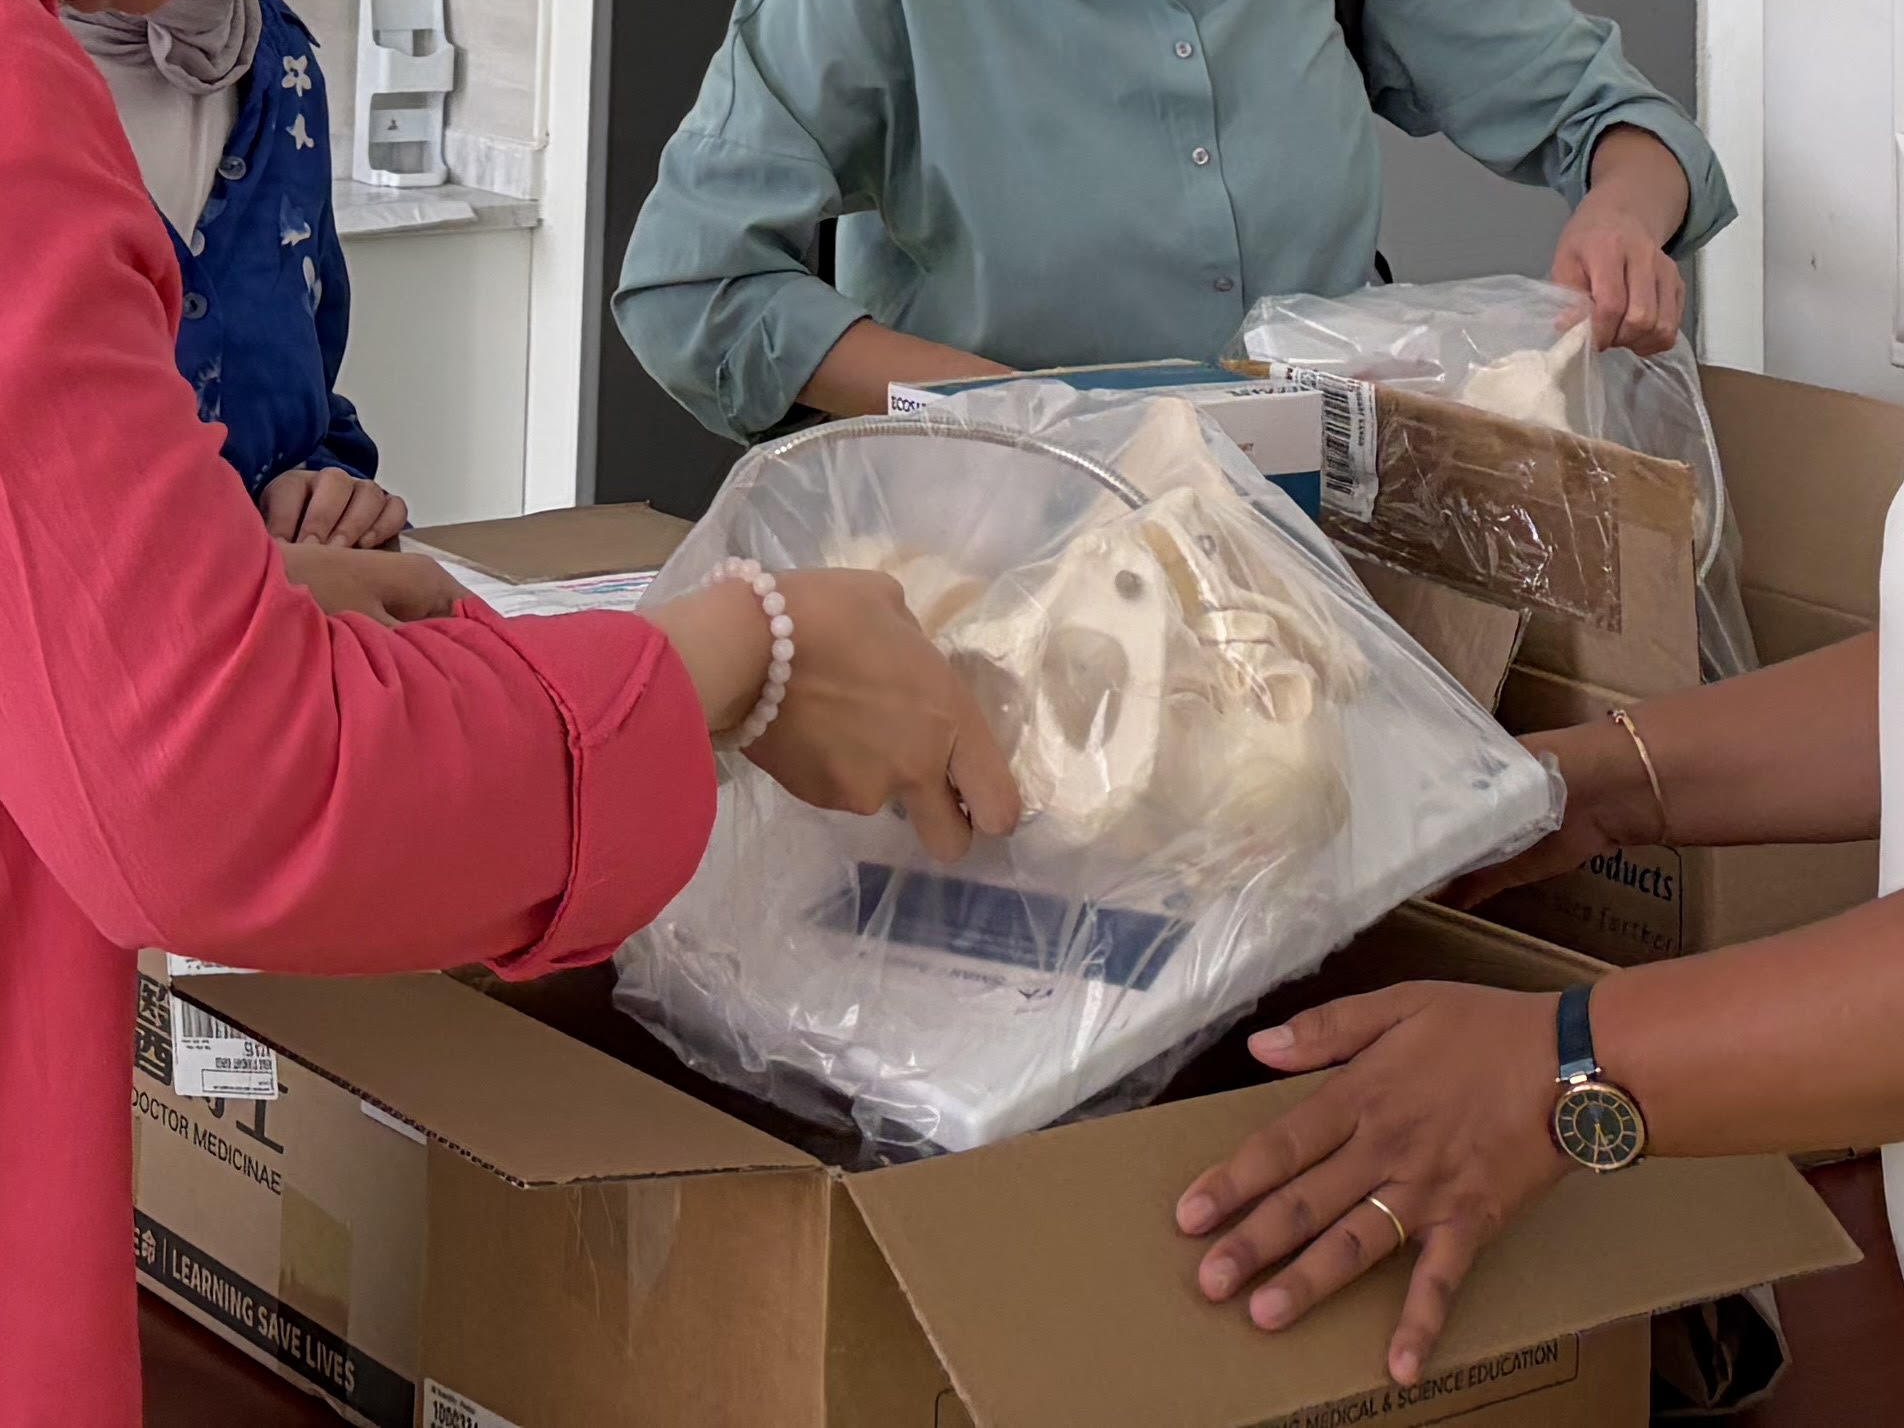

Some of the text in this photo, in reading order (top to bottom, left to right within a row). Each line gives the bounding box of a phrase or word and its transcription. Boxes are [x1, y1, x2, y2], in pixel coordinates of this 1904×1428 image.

[1590, 847, 1673, 902] oducts
[194, 1121, 283, 1196] MEDICINAE
[172, 1248, 356, 1393] LEARNING SAVE LIVES
[1381, 1392, 1393, 1412] &
[1397, 1369, 1465, 1409] SCIENCE
[1468, 1337, 1559, 1387] EDUCATION
